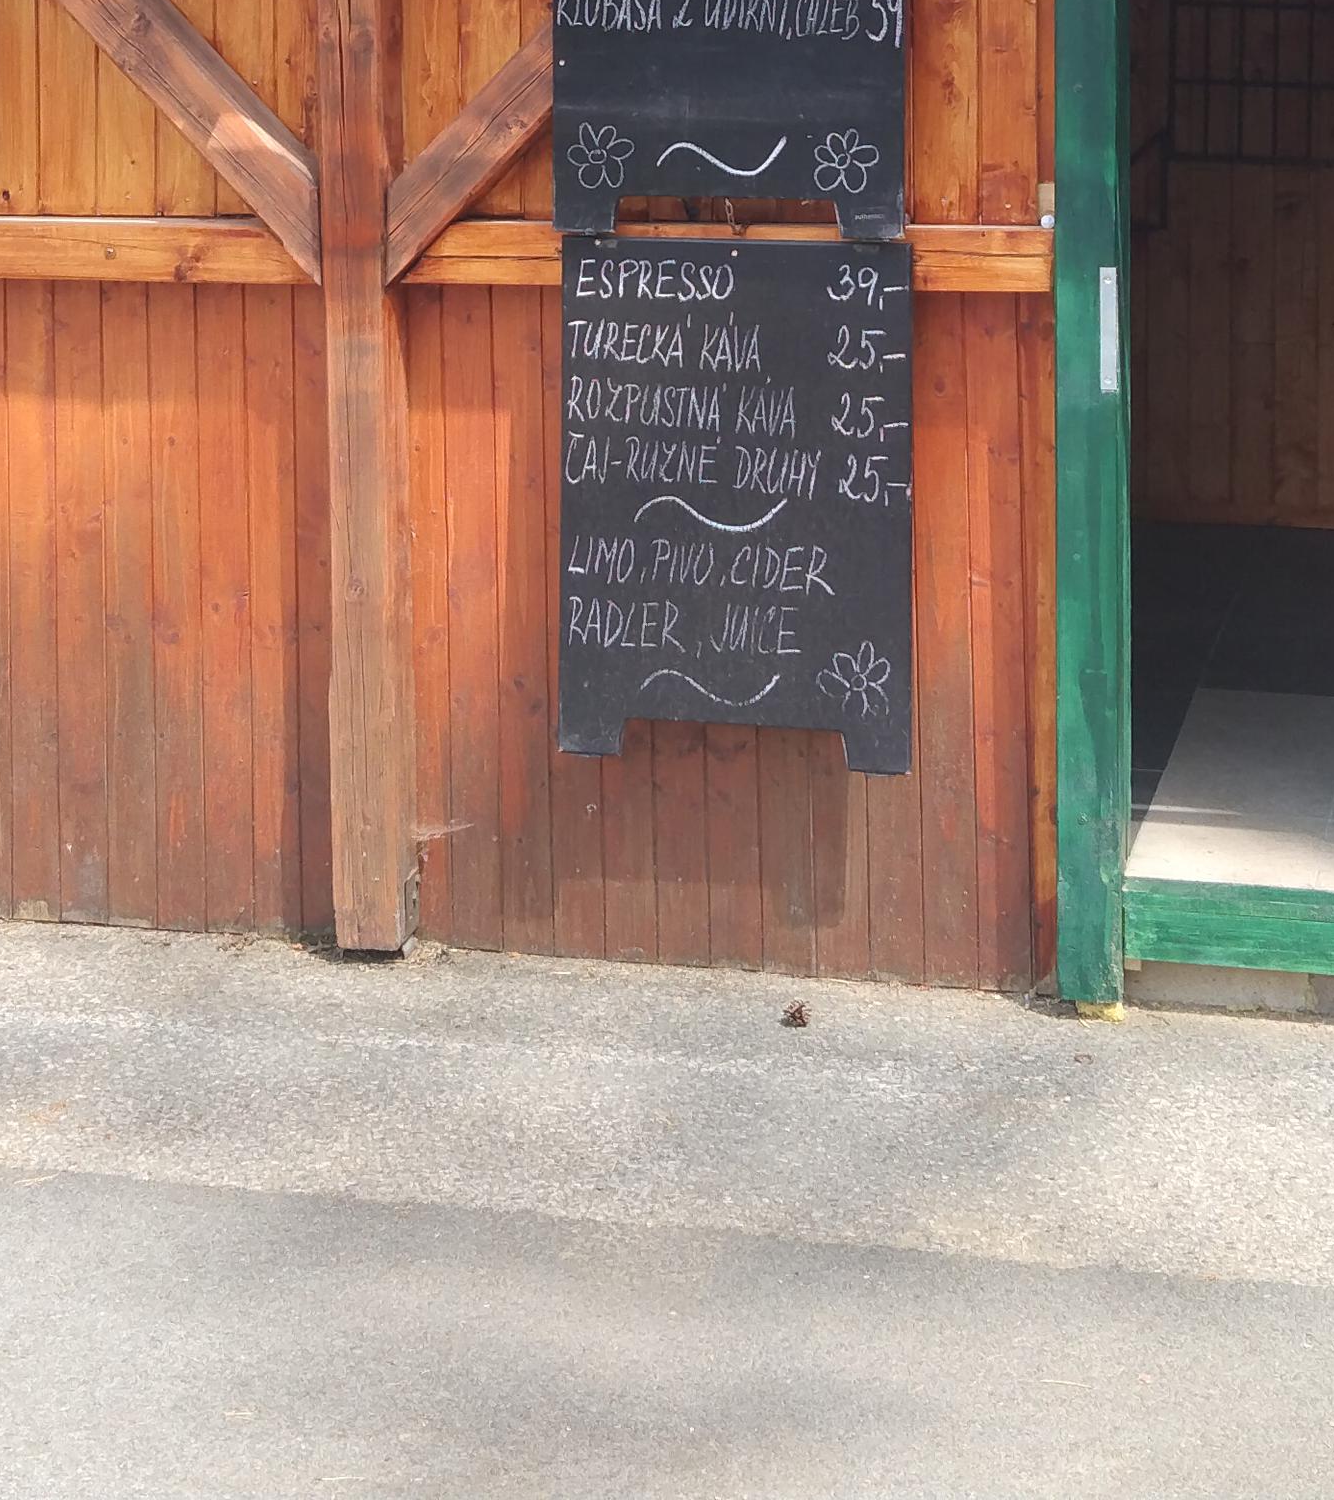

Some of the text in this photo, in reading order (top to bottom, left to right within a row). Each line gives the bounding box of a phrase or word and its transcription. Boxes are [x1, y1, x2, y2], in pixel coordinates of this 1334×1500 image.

[576, 259, 735, 302] ESPRESSO
[567, 311, 906, 372] TURECKÁ KÁVA 25,-
[567, 375, 909, 442] ROZPUSTNÁ KÁVA 25,-
[732, 446, 822, 500] DRUHY
[730, 545, 835, 596] CIDER
[709, 603, 802, 654] JUICE
